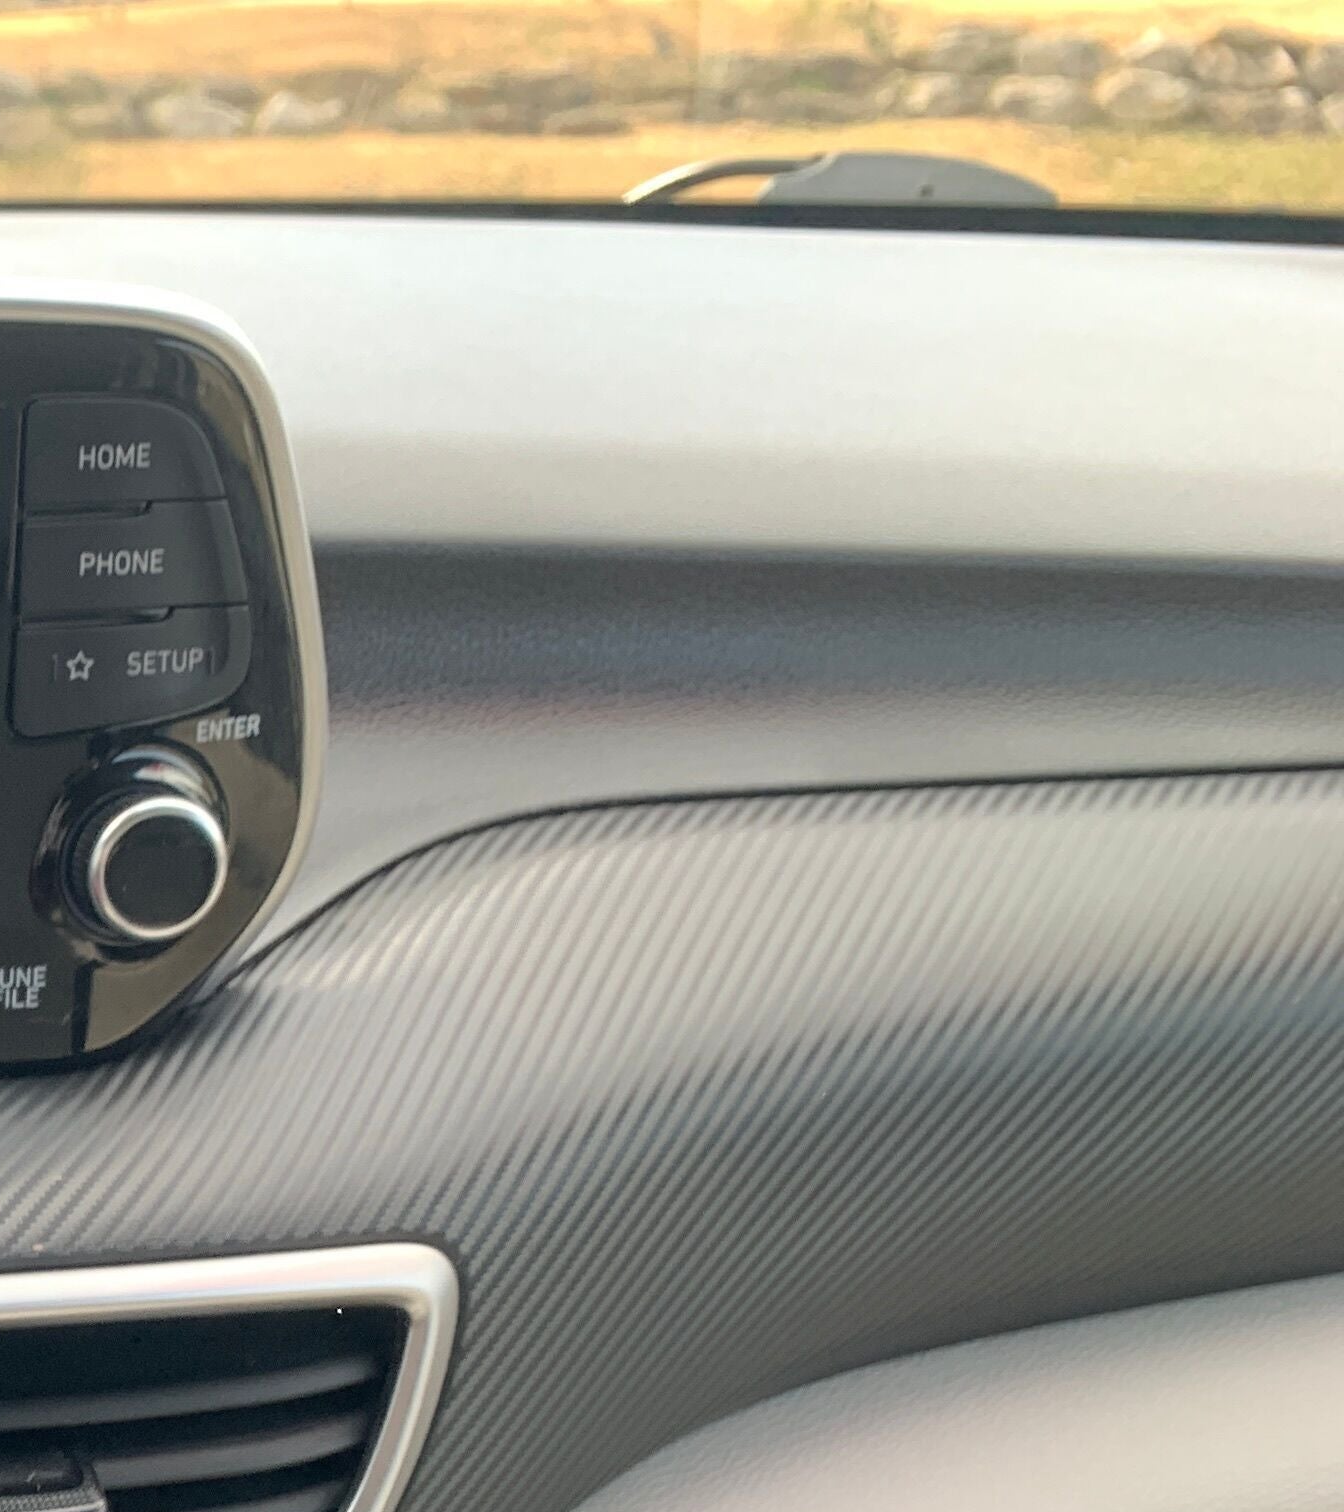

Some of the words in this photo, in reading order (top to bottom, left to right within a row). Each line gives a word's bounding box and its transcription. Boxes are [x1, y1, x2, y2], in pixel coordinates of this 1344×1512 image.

[79, 442, 151, 471] HOME
[79, 548, 165, 577] PHONE
[126, 649, 203, 677] SETUP
[196, 715, 261, 743] ENTER
